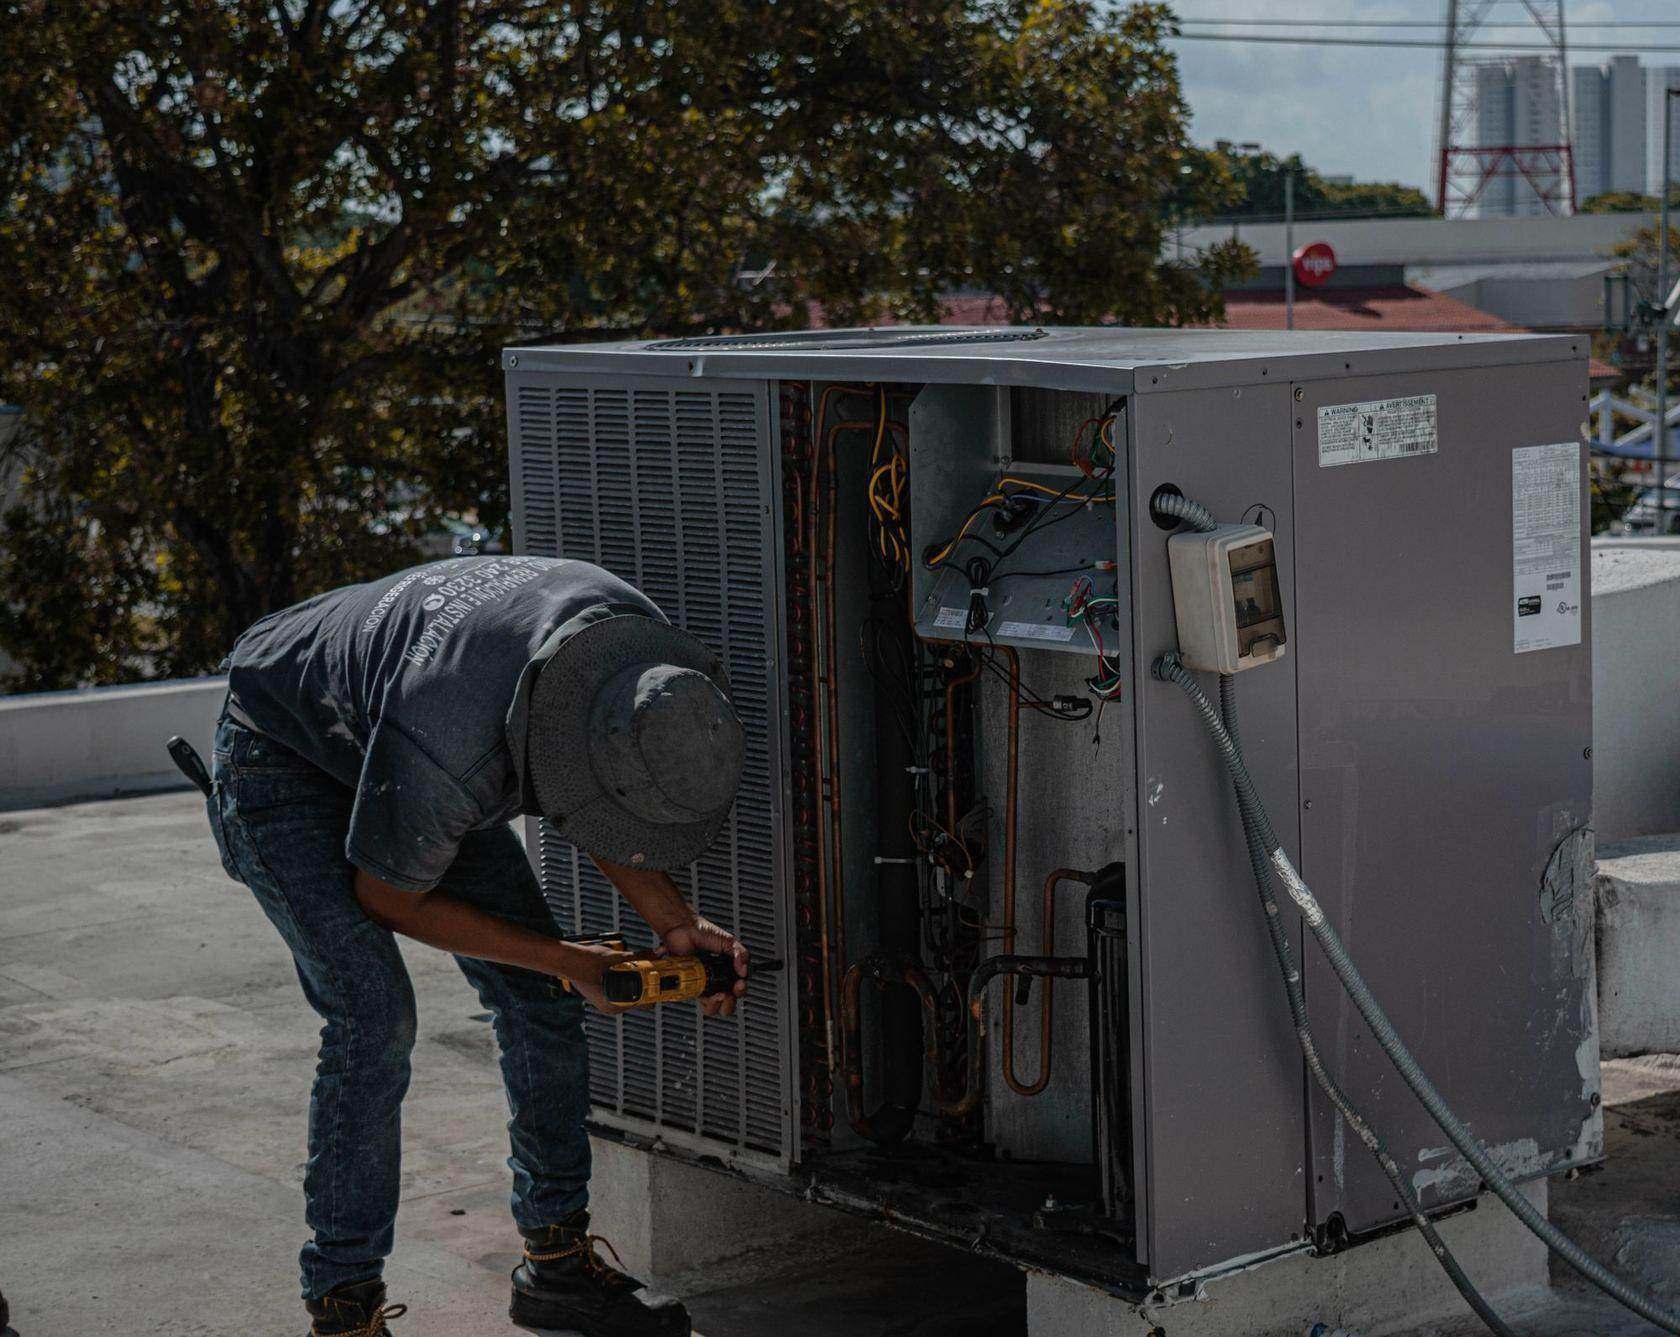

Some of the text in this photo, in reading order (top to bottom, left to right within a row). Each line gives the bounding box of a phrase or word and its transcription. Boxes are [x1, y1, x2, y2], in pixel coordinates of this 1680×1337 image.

[1386, 397, 1429, 409] AVERTISSEMENT
[1330, 406, 1358, 415] WARNING
[438, 575, 482, 597] 3230
[460, 592, 482, 606] E
[404, 597, 476, 667] INSTALACIÓN
